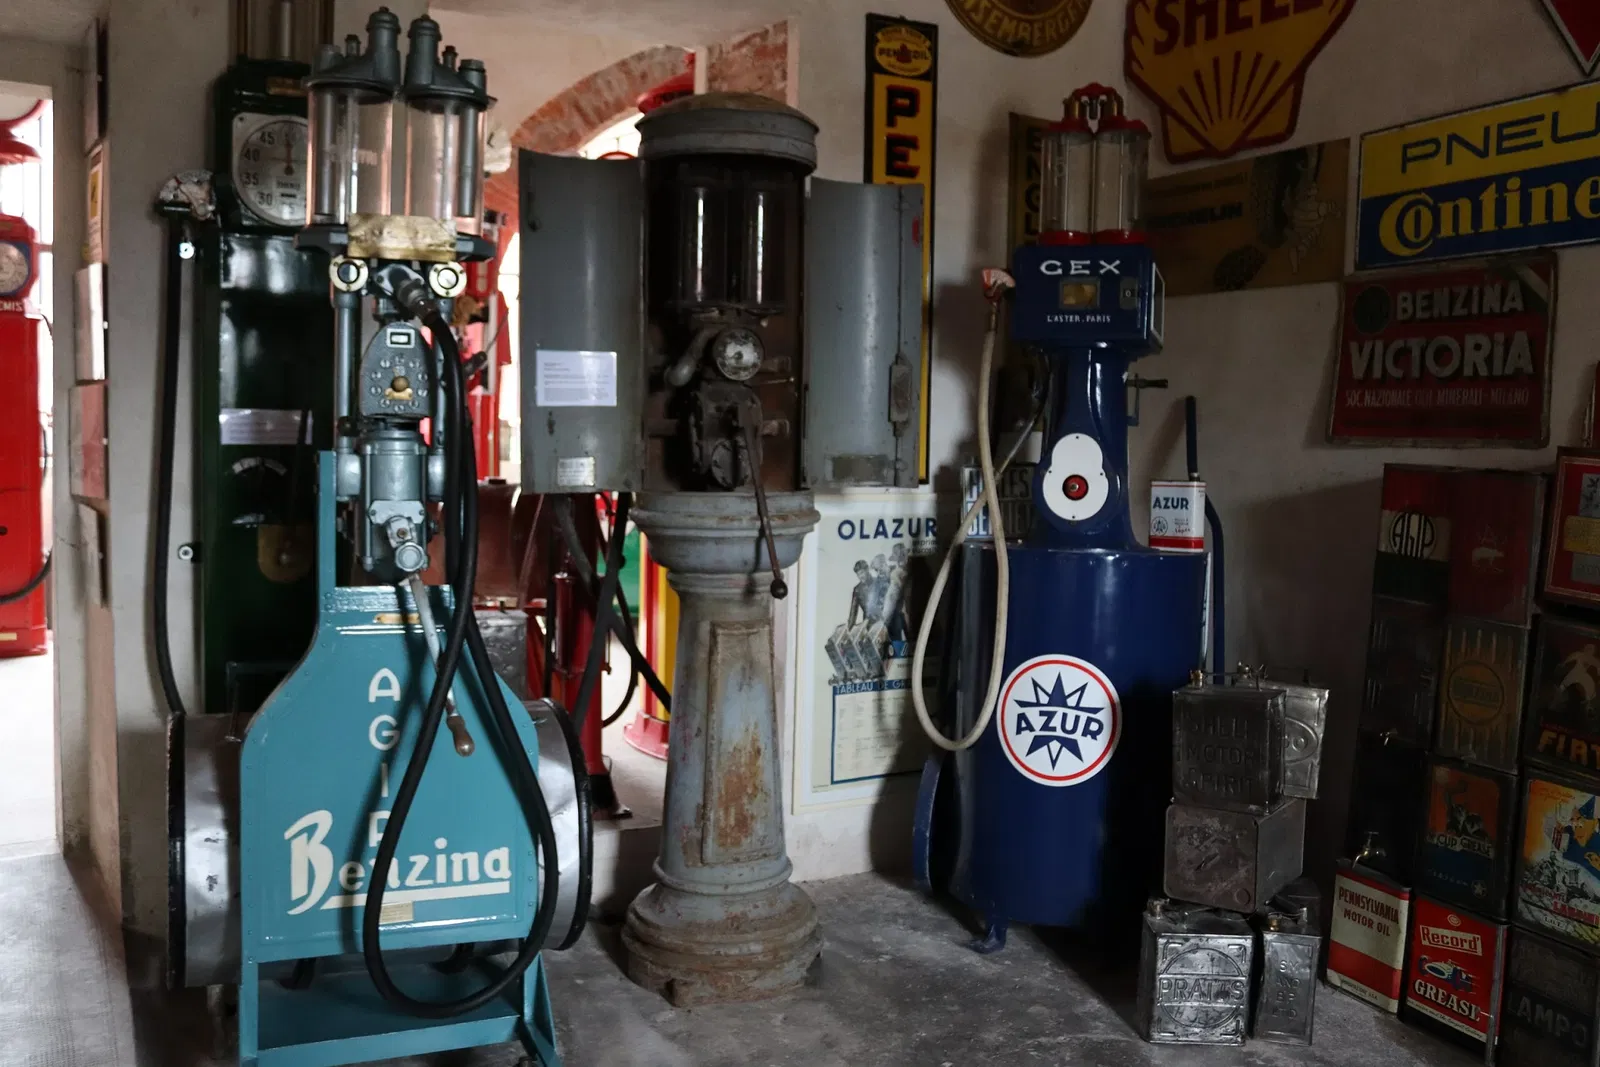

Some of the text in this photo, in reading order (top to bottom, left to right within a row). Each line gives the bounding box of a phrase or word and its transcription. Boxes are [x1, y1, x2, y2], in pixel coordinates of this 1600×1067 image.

[1154, 0, 1324, 55] SHE
[260, 131, 275, 145] 45
[245, 148, 261, 157] 40
[243, 173, 259, 186] 35
[257, 192, 273, 206] 30
[1040, 259, 1121, 275] GEX
[1396, 280, 1525, 321] BENZINA
[1349, 330, 1535, 380] VICTORIA
[1152, 496, 1190, 510] AZUR
[837, 517, 937, 541] OLAZUR
[836, 681, 874, 695] TABLEAU
[1015, 710, 1104, 741] AZUR
[1338, 886, 1400, 925] PENNSYLVANIA
[1343, 907, 1391, 937] MOTOR OIL
